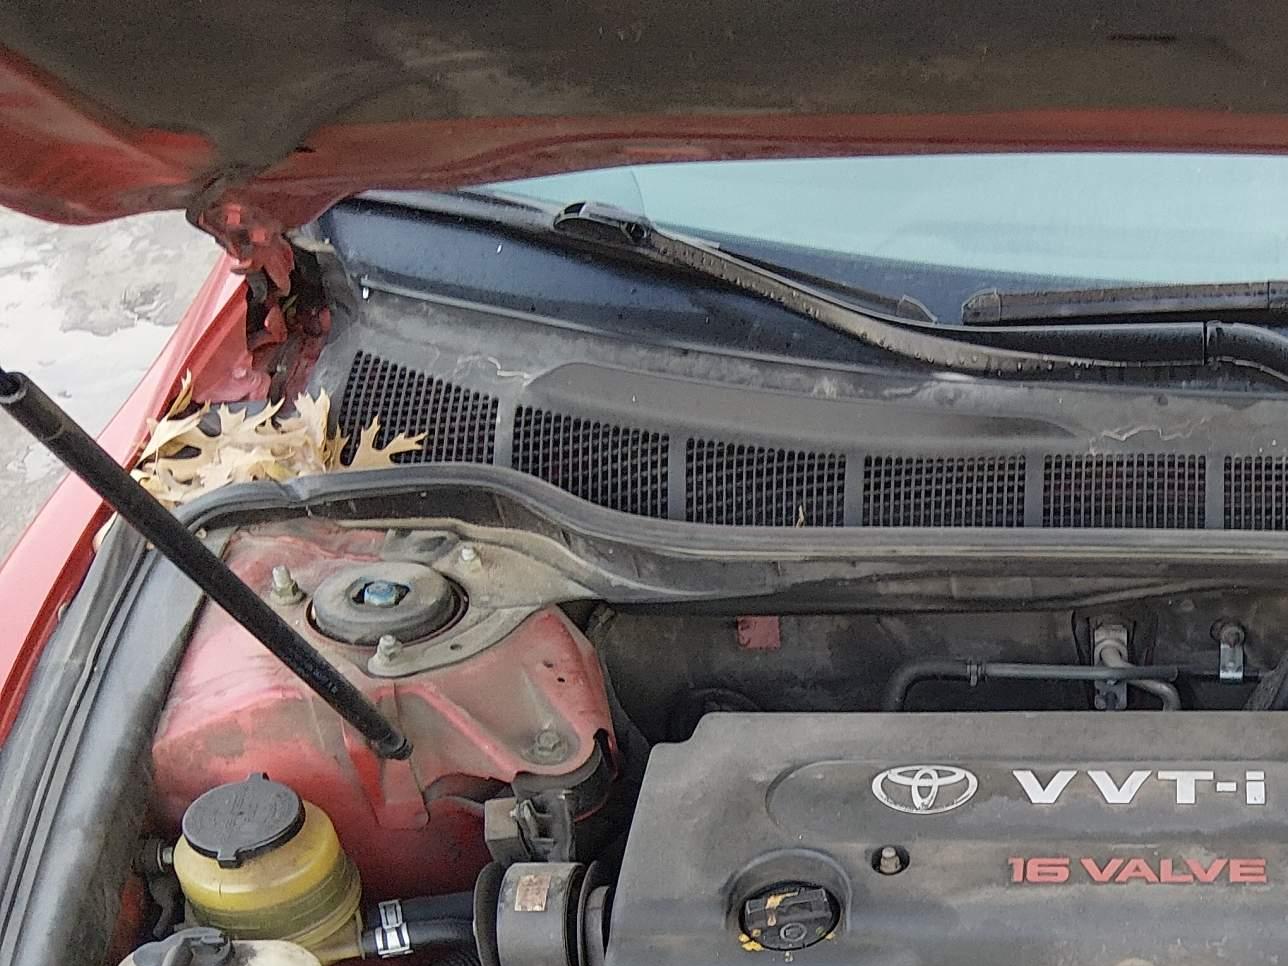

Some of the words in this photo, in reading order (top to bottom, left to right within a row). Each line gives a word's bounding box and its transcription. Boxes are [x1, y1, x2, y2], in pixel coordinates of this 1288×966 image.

[1012, 770, 1266, 805] VVT-i
[1008, 857, 1071, 883] 16
[1080, 857, 1267, 884] VALVE
